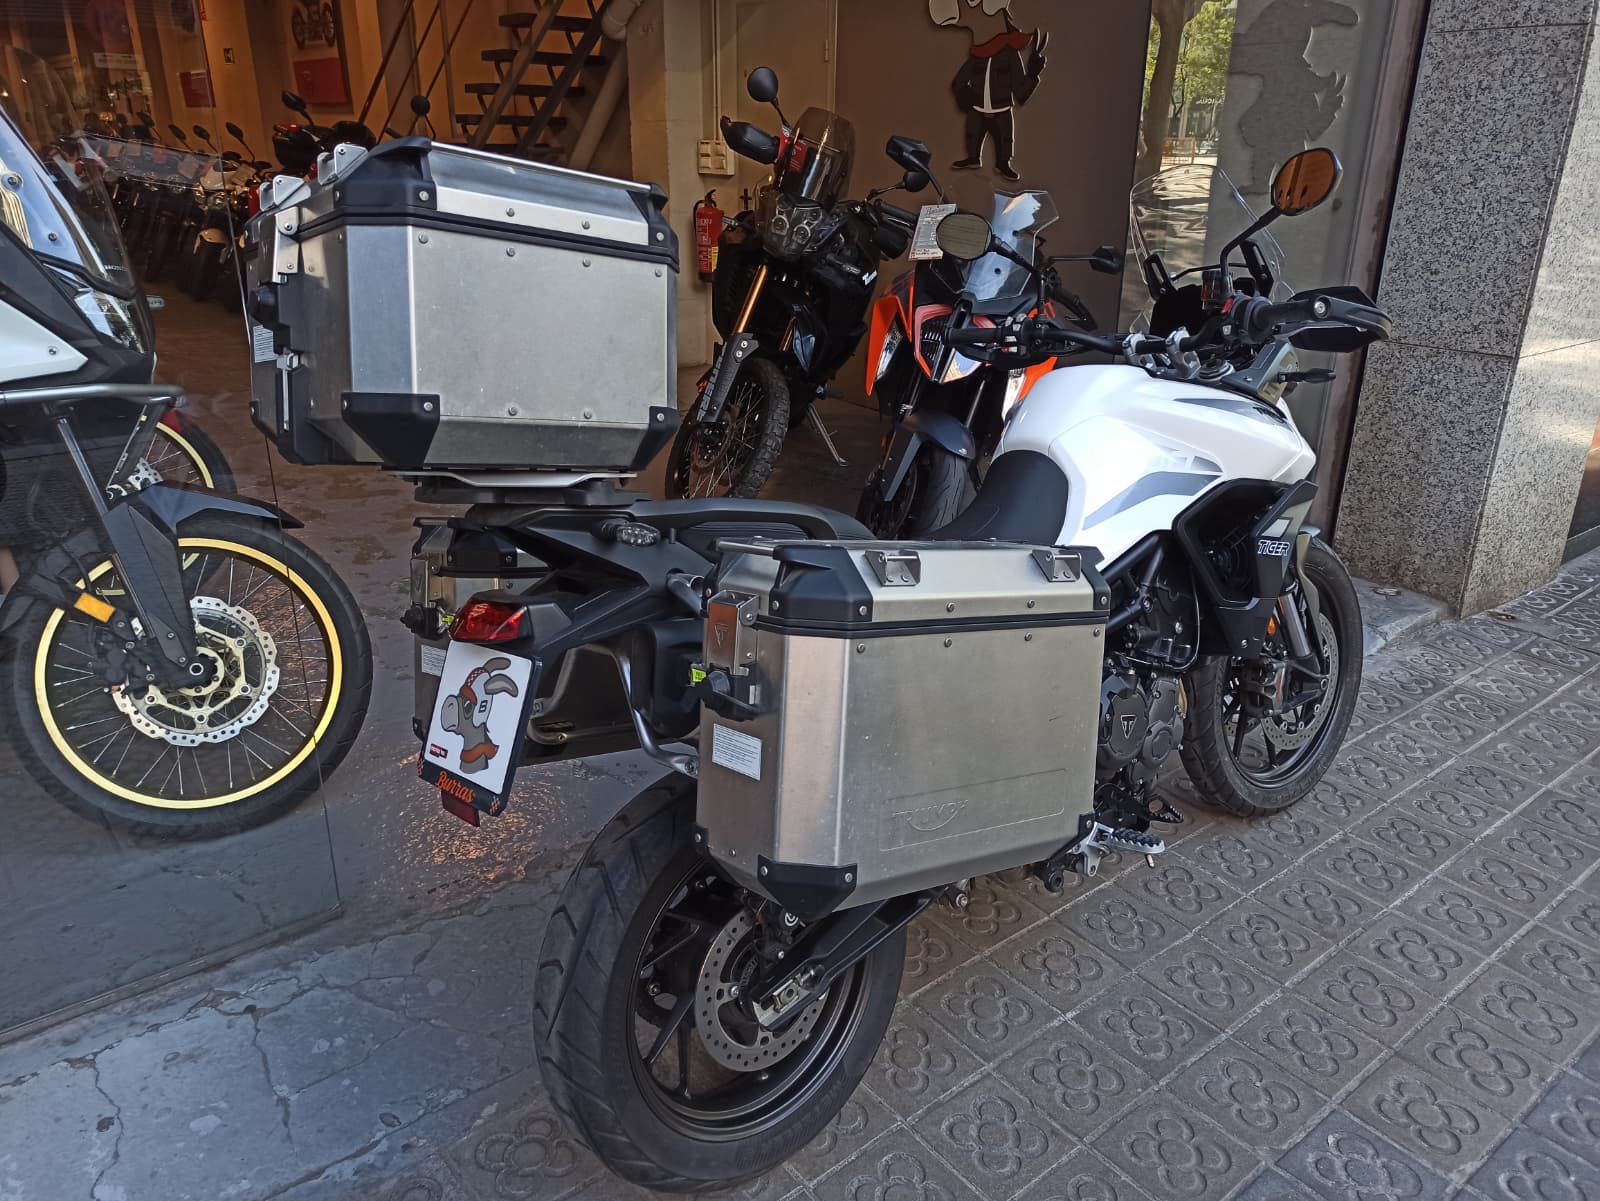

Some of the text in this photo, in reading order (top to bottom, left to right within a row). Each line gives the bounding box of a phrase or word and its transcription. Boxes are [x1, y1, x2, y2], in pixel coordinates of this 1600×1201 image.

[1257, 539, 1290, 556] TIGER
[478, 699, 488, 713] B
[435, 770, 476, 803] Burras
